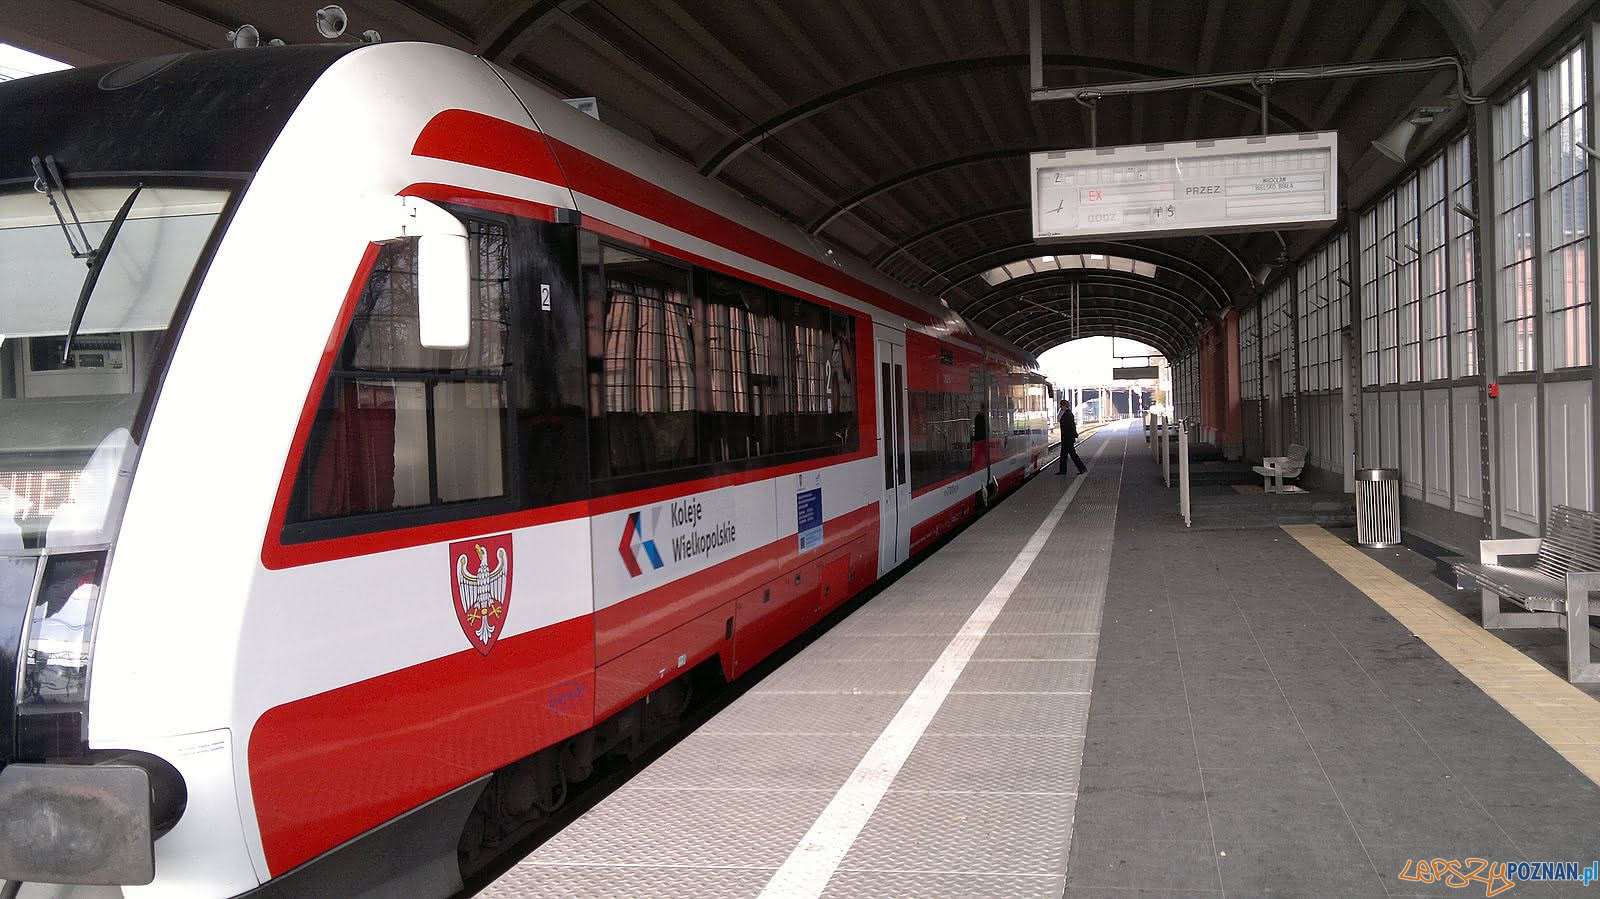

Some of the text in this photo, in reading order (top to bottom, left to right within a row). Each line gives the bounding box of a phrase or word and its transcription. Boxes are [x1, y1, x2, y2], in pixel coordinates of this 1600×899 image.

[1088, 190, 1103, 202] EX
[1186, 185, 1221, 196] PRZEZ
[542, 287, 550, 306] 2
[825, 359, 833, 394] 2
[670, 498, 702, 528] Koleje
[671, 520, 736, 563] Wielkopolskie
